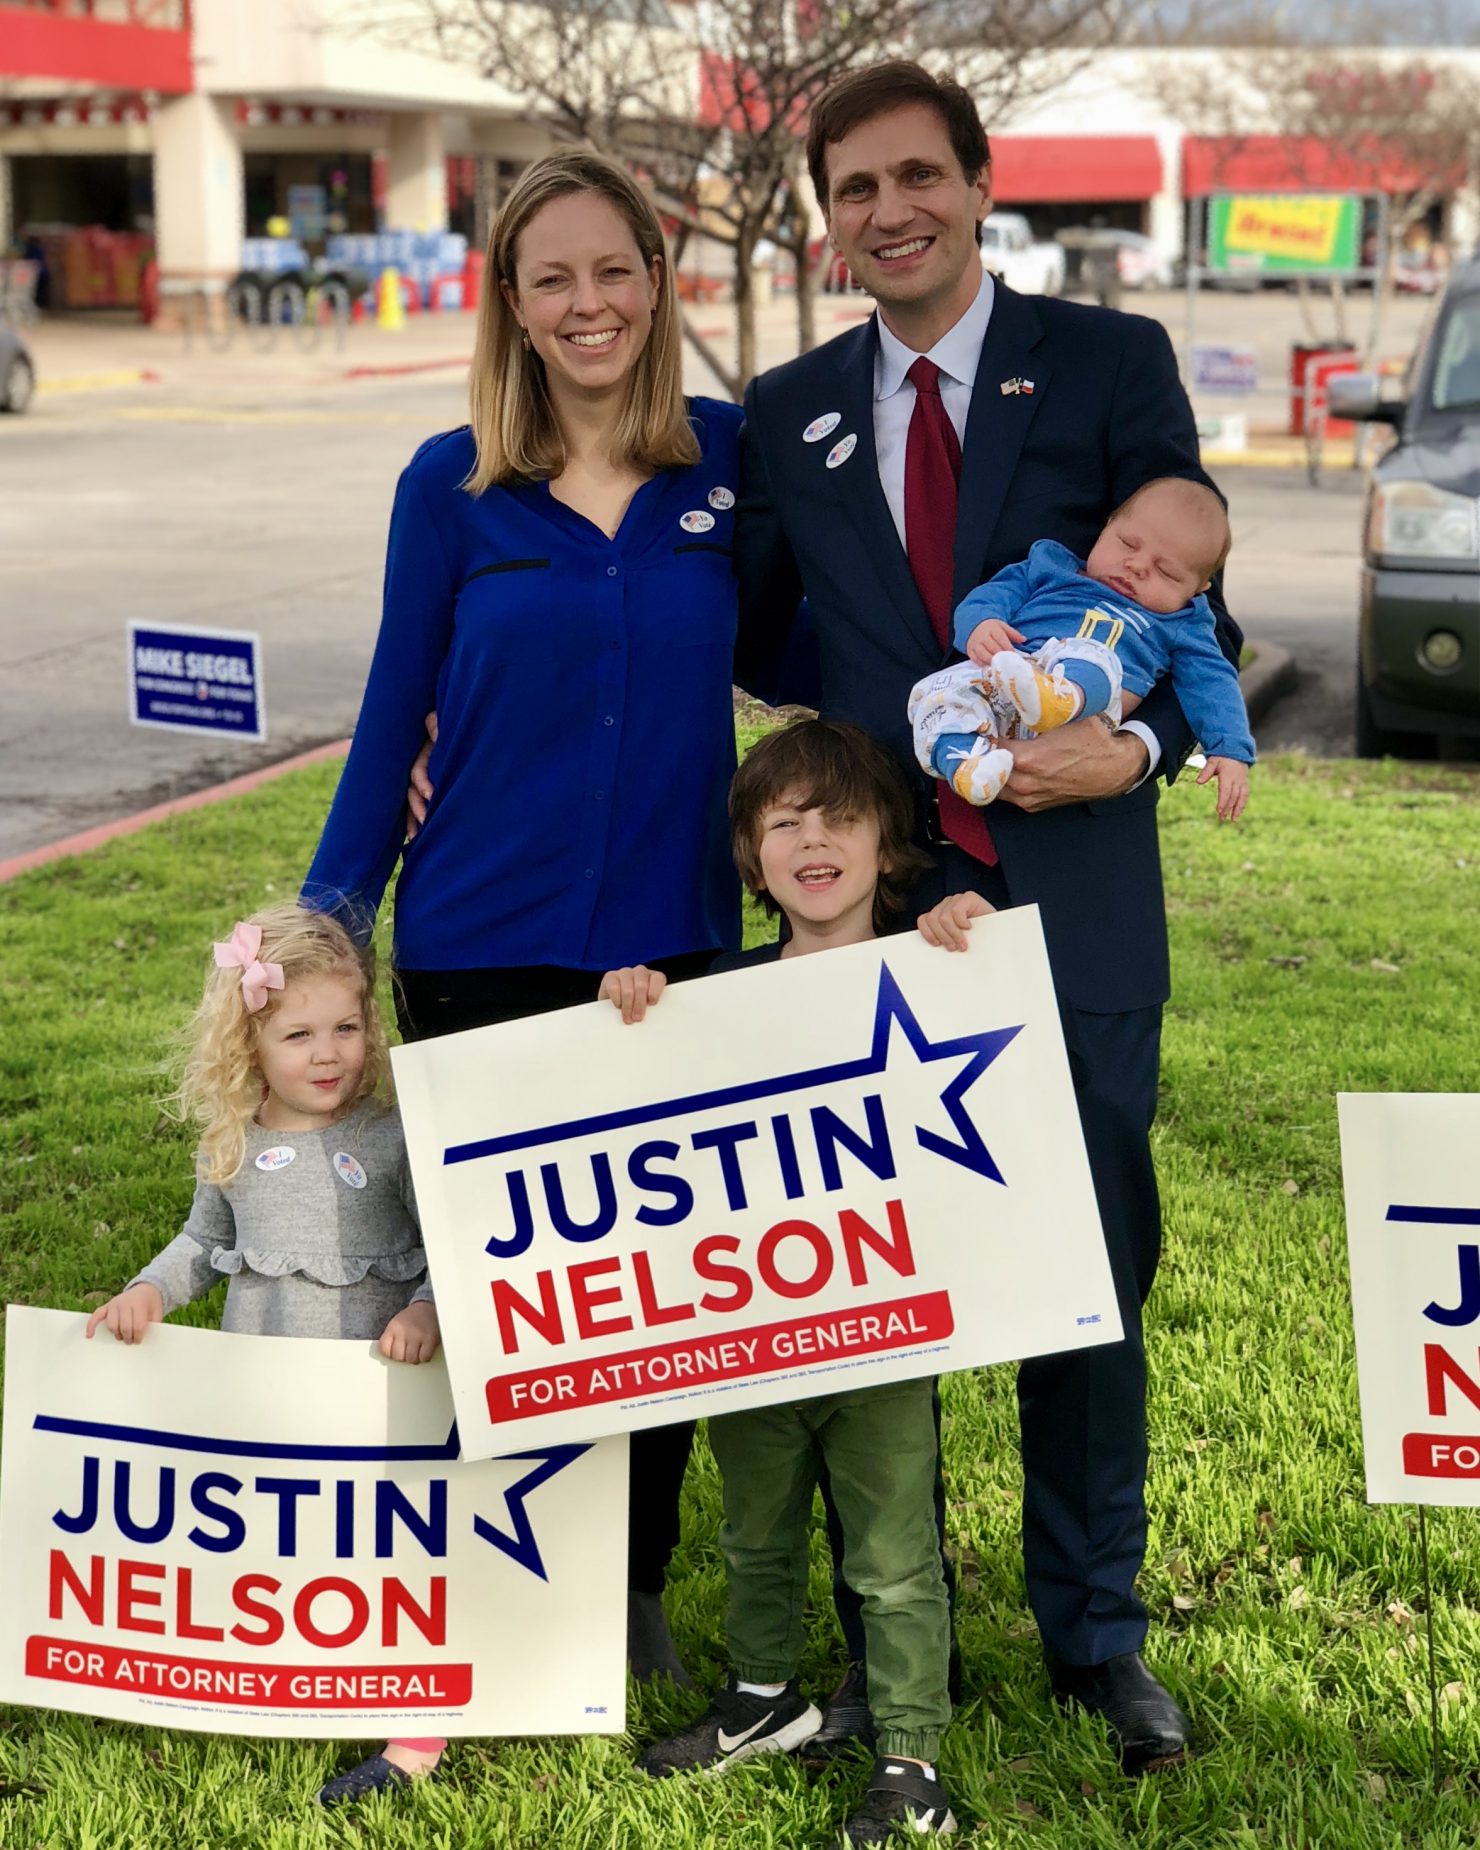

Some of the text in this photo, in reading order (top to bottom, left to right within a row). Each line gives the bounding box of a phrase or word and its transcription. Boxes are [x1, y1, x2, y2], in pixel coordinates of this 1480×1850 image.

[136, 646, 253, 685] MIKE SIEGEL
[484, 1094, 897, 1259] JUSTIN
[490, 1199, 916, 1355] NELSON
[510, 1308, 928, 1409] FOR ATTORNEY GENERAL
[51, 1456, 448, 1558] JUSTIN
[48, 1549, 447, 1649] NELSON
[46, 1647, 446, 1699] FOR ATTORNEY GENERAL
